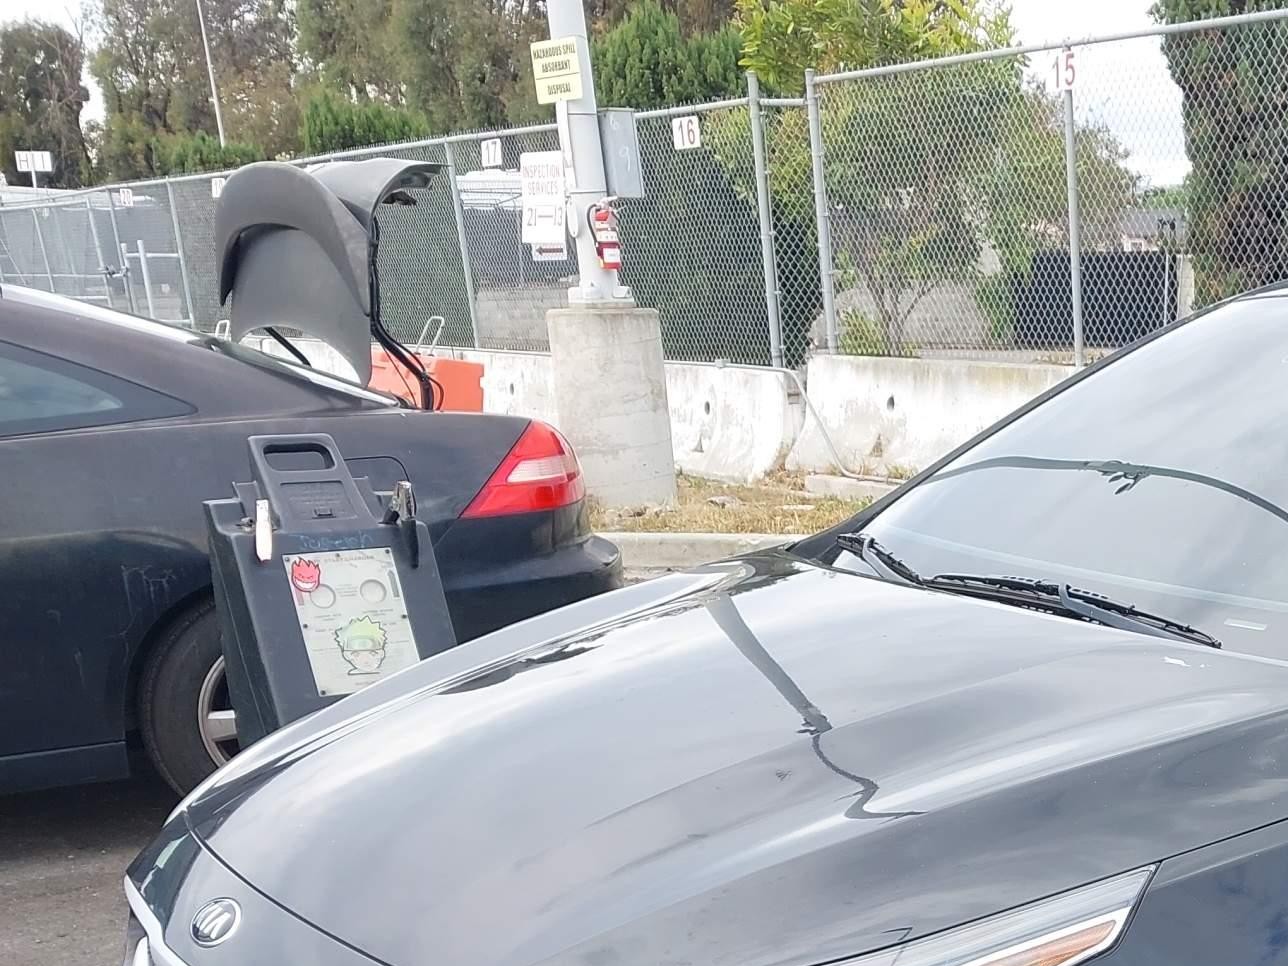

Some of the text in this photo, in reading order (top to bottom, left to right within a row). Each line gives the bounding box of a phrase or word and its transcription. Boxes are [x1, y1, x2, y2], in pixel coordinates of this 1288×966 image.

[562, 43, 576, 54] SPILL
[1052, 53, 1075, 88] 15
[547, 82, 571, 95] DISPOSAL
[678, 119, 696, 146] 16
[486, 141, 498, 164] 17
[523, 164, 560, 178] INSPECTION
[528, 181, 559, 195] SERVICES
